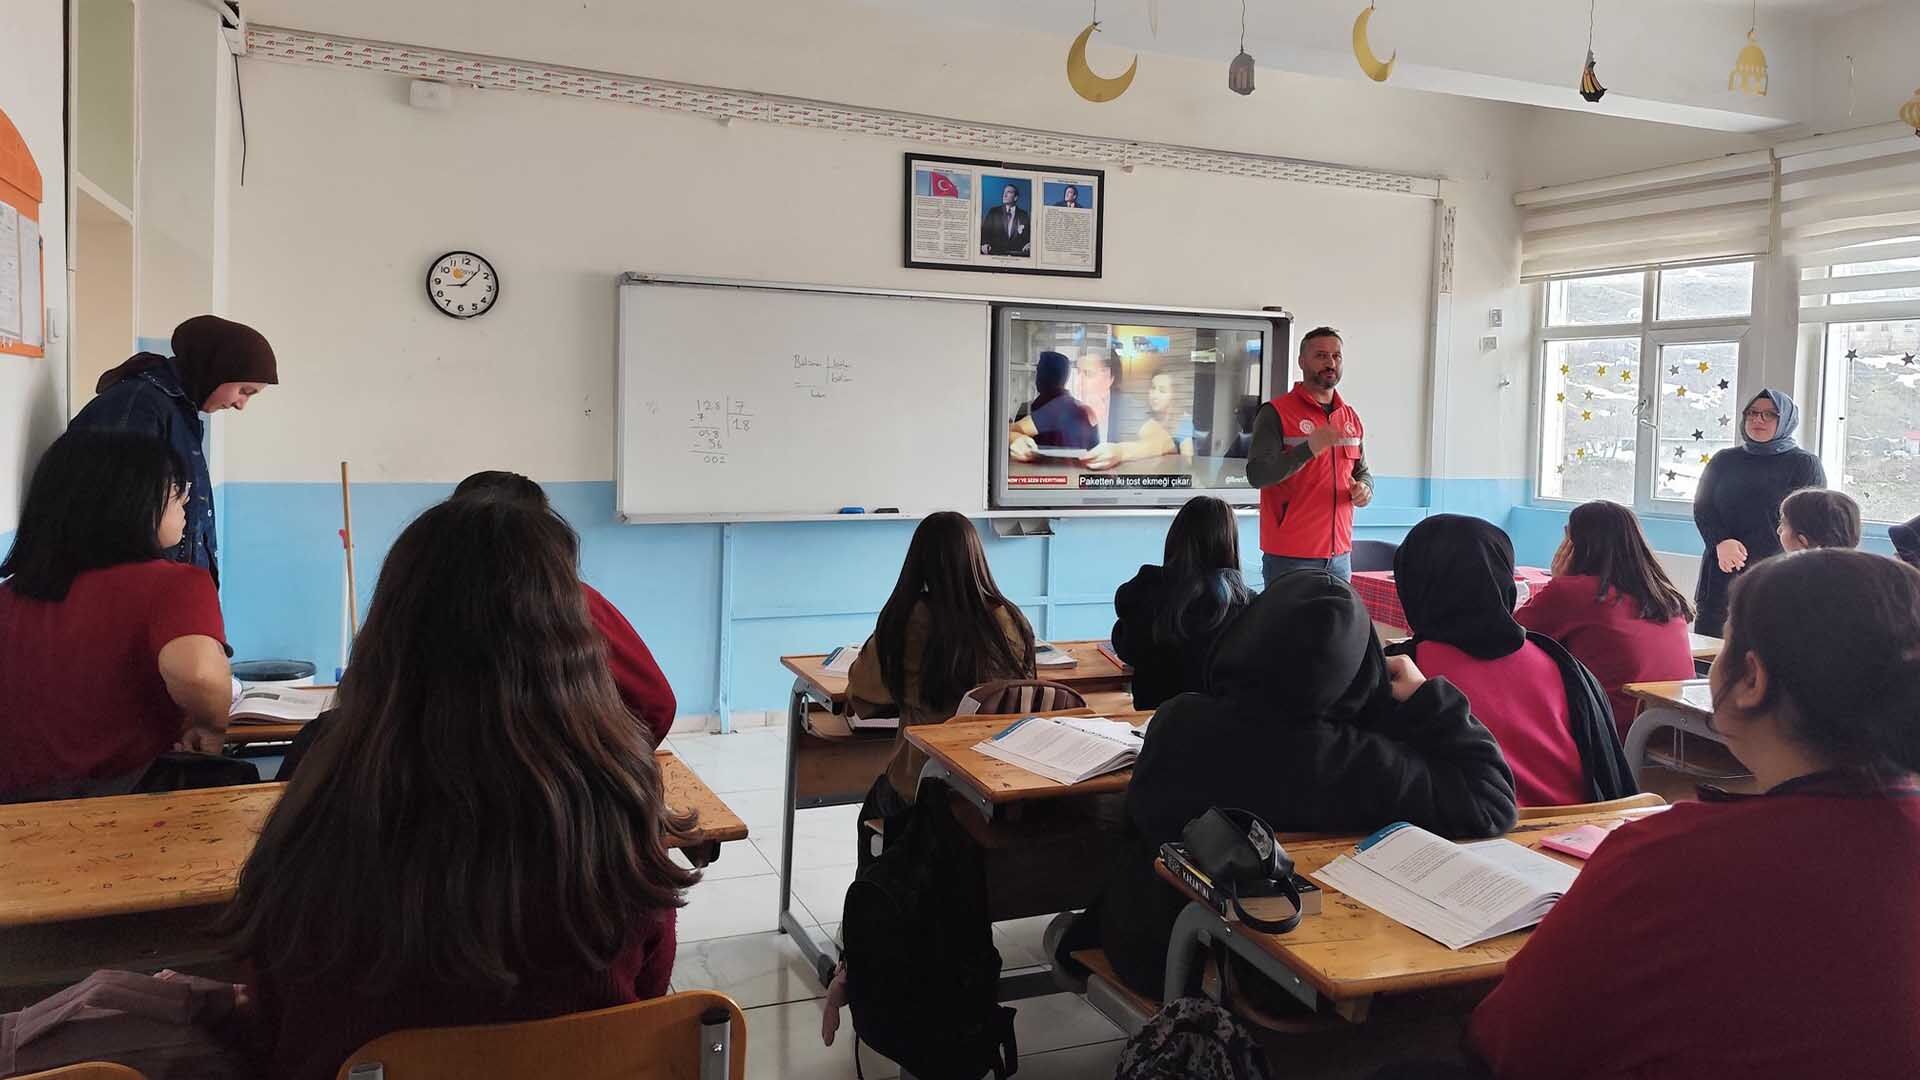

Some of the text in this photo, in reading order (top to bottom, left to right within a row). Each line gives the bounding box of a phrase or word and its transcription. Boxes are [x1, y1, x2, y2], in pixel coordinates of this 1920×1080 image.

[1080, 476, 1114, 486] Paketten
[1116, 476, 1124, 486] iki
[1126, 476, 1140, 486] tost
[1142, 476, 1170, 488] ekmeği
